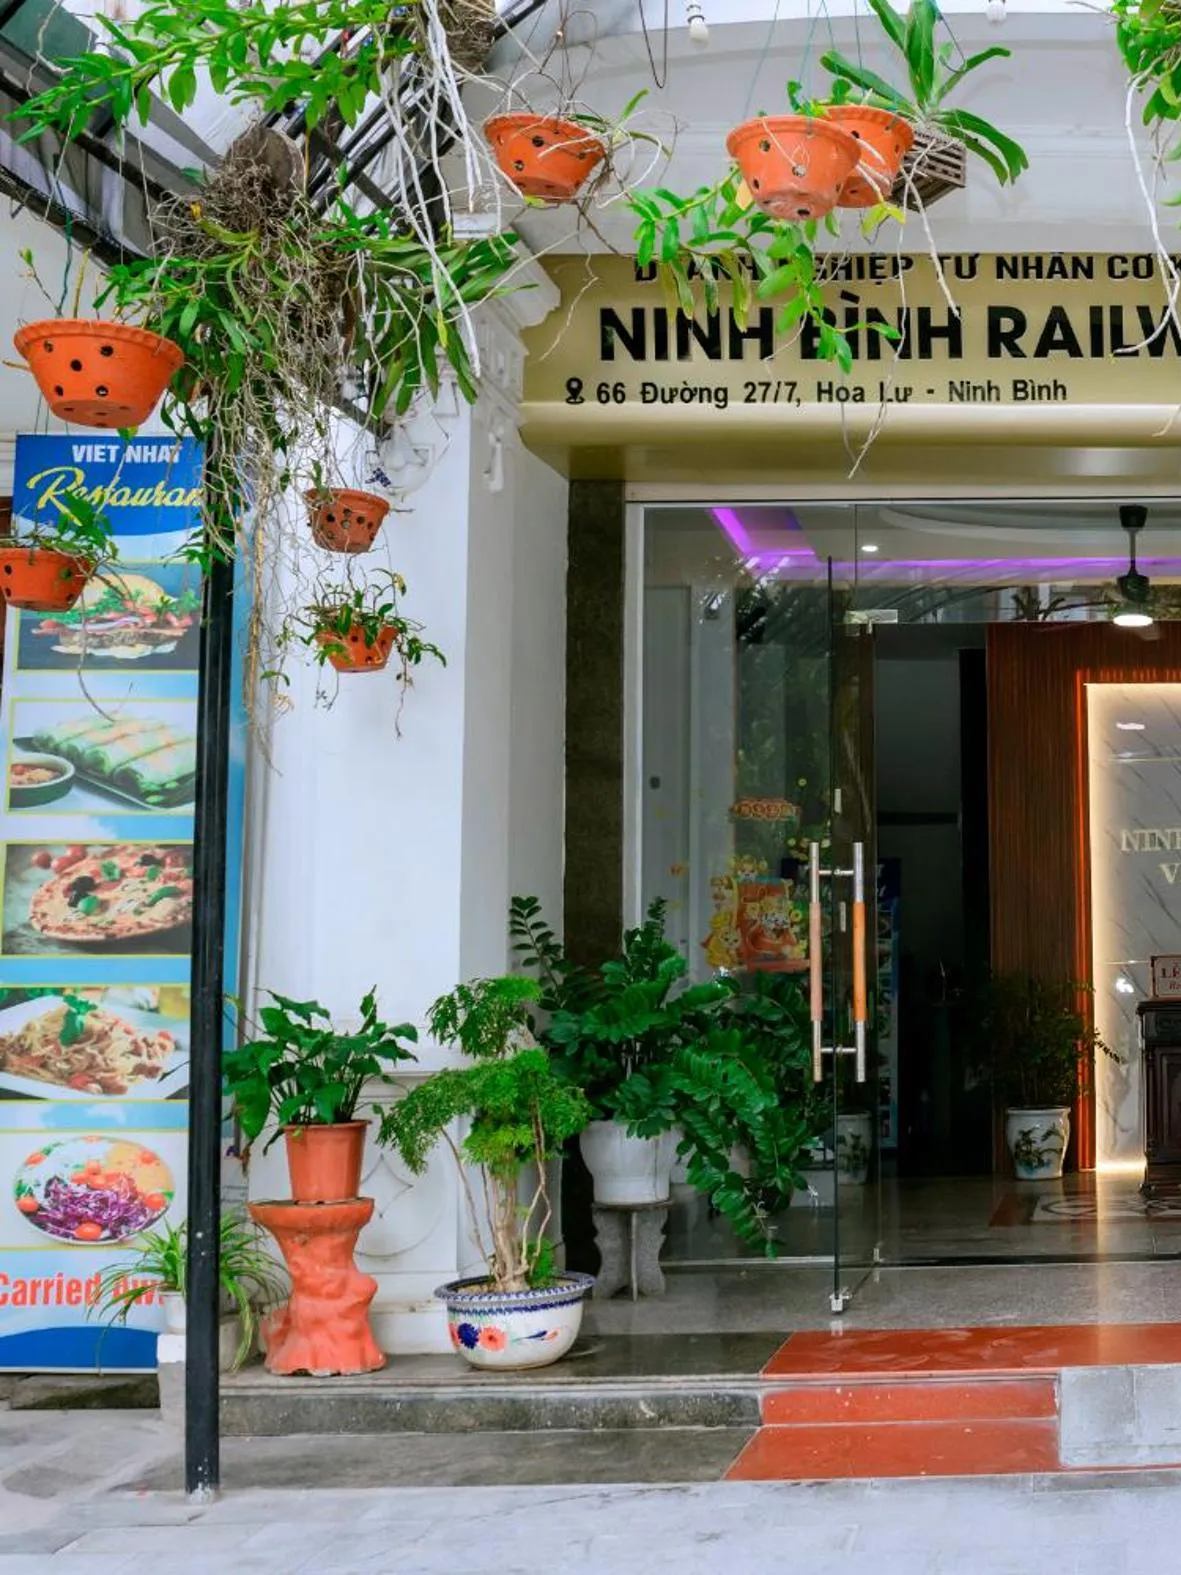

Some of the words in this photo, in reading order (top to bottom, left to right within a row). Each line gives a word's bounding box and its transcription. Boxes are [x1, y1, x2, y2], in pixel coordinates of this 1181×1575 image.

[600, 306, 774, 361] NINH
[801, 289, 962, 361] BÌNH
[597, 382, 626, 404] 66
[640, 380, 729, 408] Đường
[743, 381, 802, 408] 27/7,
[817, 381, 866, 403] Hoa
[948, 381, 1001, 402] Ninh
[1012, 379, 1068, 401] Bình
[72, 444, 120, 463] VIET
[26, 466, 204, 527] Restauran
